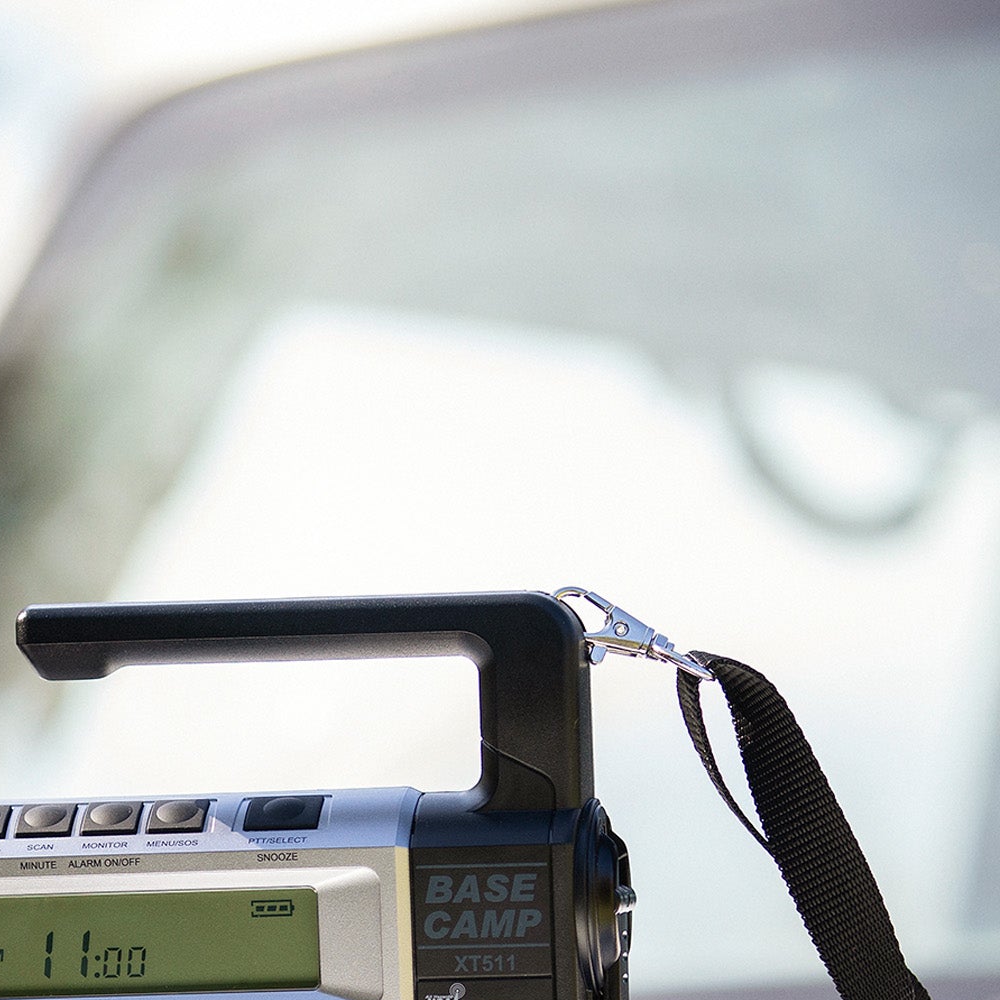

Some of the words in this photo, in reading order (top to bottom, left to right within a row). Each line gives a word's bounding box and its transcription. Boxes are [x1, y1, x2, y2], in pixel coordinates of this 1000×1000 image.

[81, 841, 128, 849] MONITOR
[146, 839, 199, 847] MENU/SOS
[247, 836, 308, 845] PTT/SELECT
[27, 843, 54, 851] SCAN
[68, 859, 101, 869] ALARM
[104, 857, 141, 868] ON/OFF
[256, 852, 298, 863] SNOOZE
[20, 860, 57, 871] MINUTE
[425, 873, 537, 904] BASE
[423, 908, 542, 940] CAMP
[44, 930, 147, 979] 11:00
[454, 954, 516, 973] XT511
